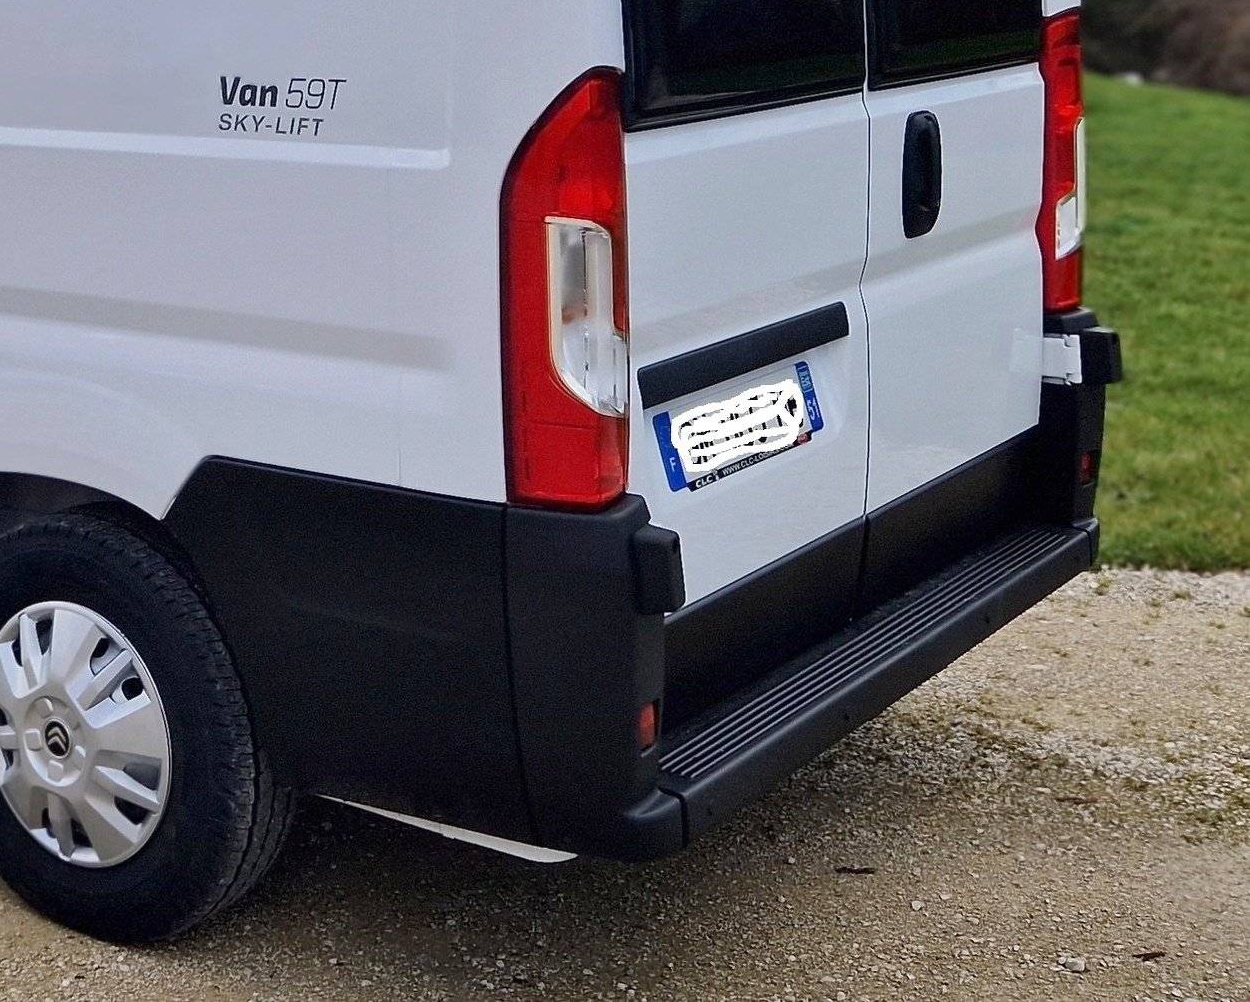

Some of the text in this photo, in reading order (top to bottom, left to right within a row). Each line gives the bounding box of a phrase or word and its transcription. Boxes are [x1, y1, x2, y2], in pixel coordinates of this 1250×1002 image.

[219, 76, 347, 110] Van 59T
[218, 113, 324, 137] SKY-LIFT
[669, 456, 677, 473] F
[695, 474, 714, 489] CLC
